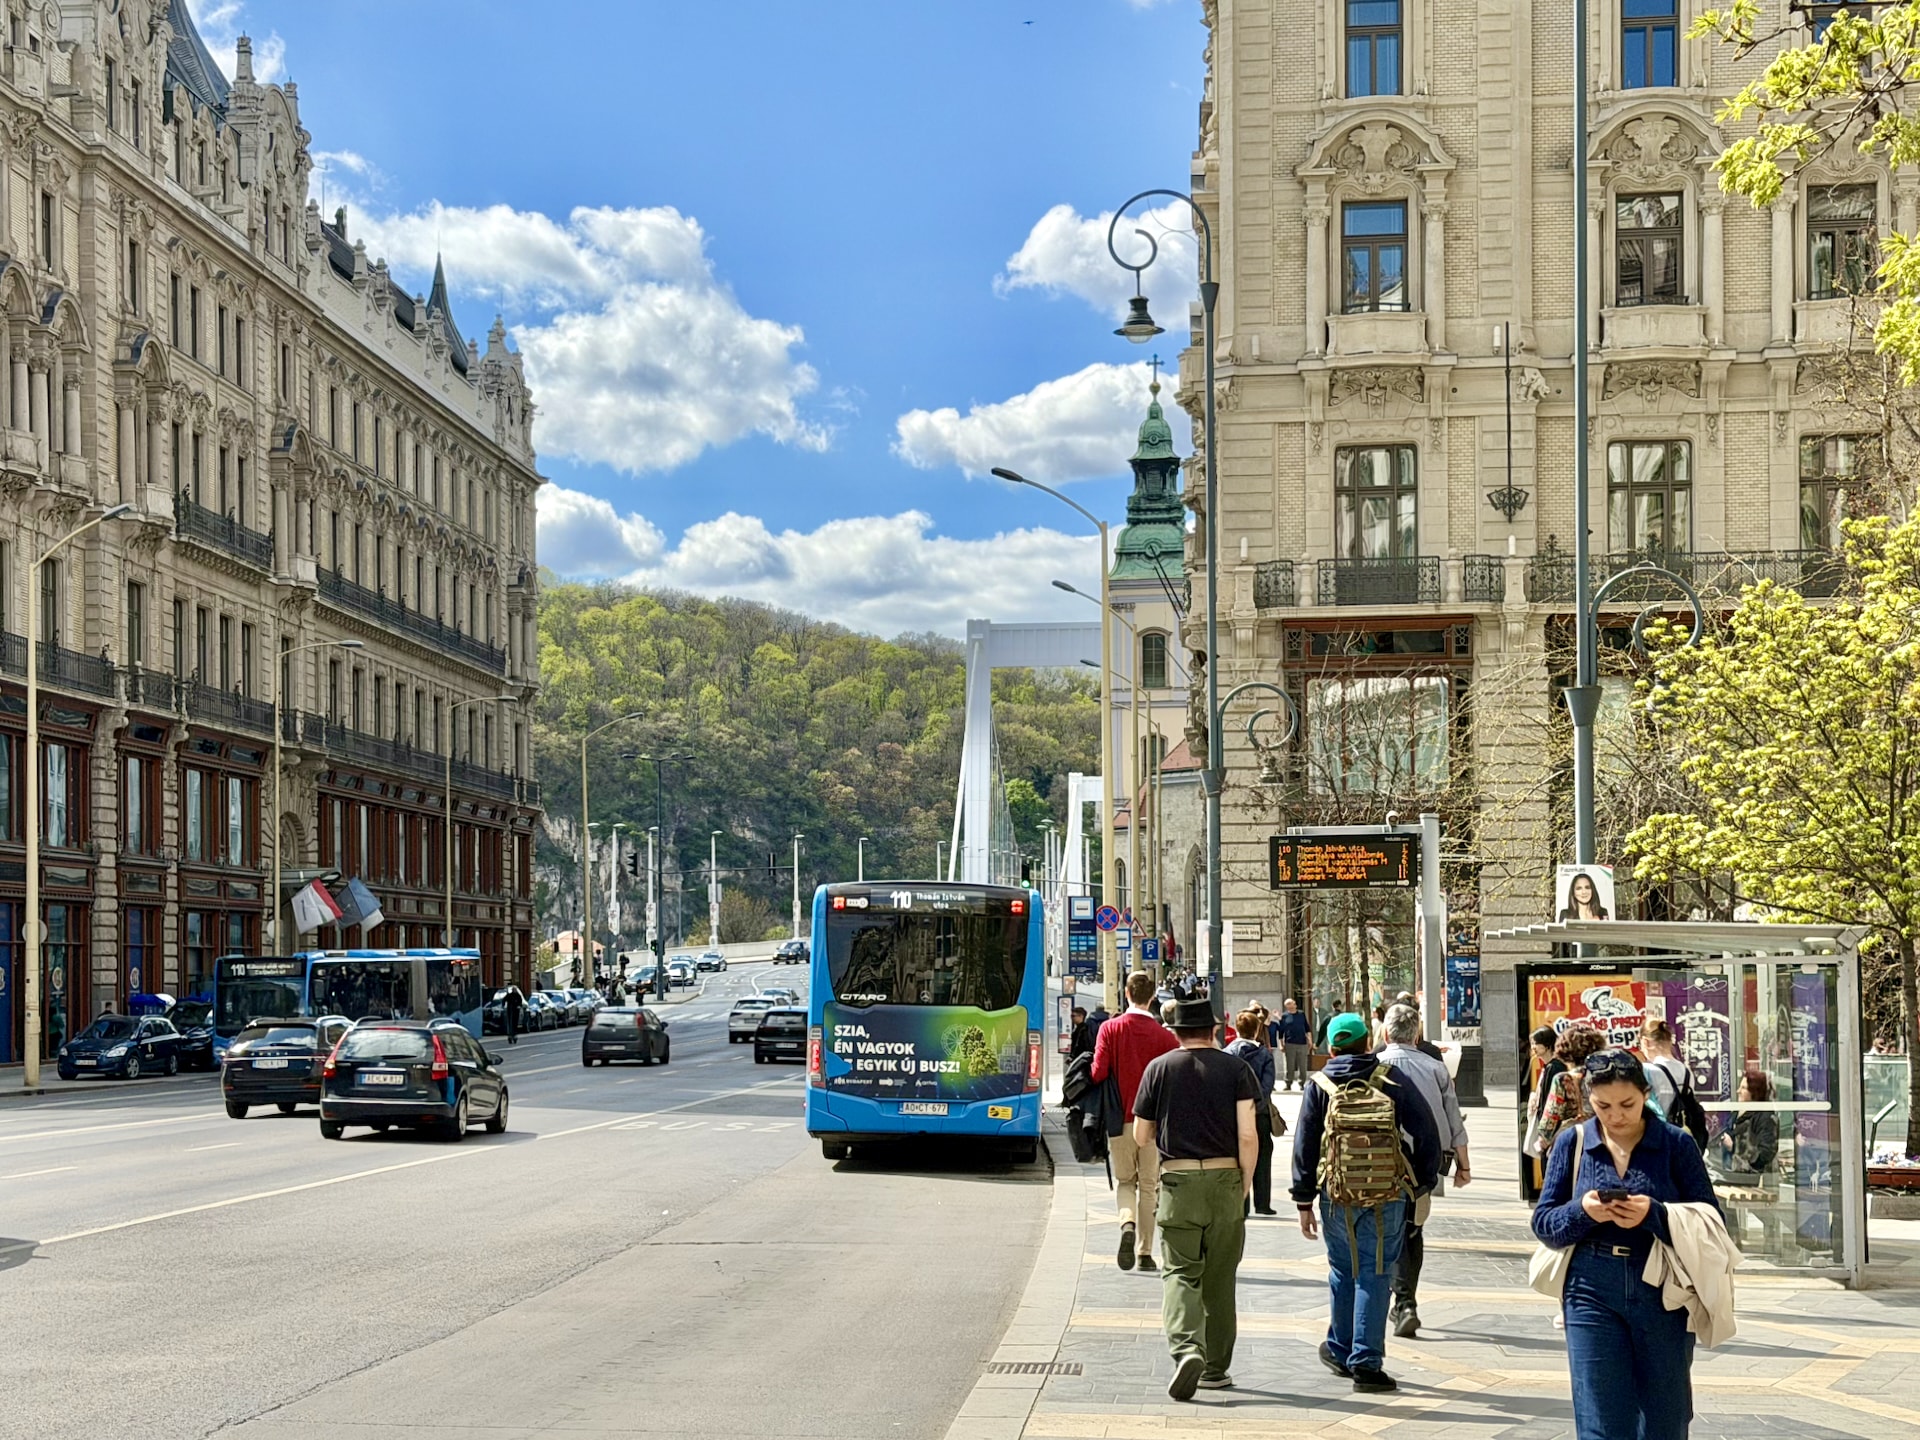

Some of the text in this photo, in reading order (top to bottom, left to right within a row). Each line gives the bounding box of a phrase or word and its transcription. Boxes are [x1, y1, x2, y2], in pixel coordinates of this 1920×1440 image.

[1297, 845, 1323, 853] Thomán
[1326, 844, 1347, 852] István
[1349, 865, 1366, 873] utca
[890, 891, 966, 909] 110 Thomán István
[1147, 944, 1155, 954] P
[231, 964, 246, 976] 110
[834, 1025, 870, 1039] SZIA,
[834, 1039, 915, 1055] ÉN VAGYOK
[857, 1059, 898, 1072] EGYIK
[901, 1057, 916, 1075] ÚJ
[920, 1060, 960, 1073] BUSZ!
